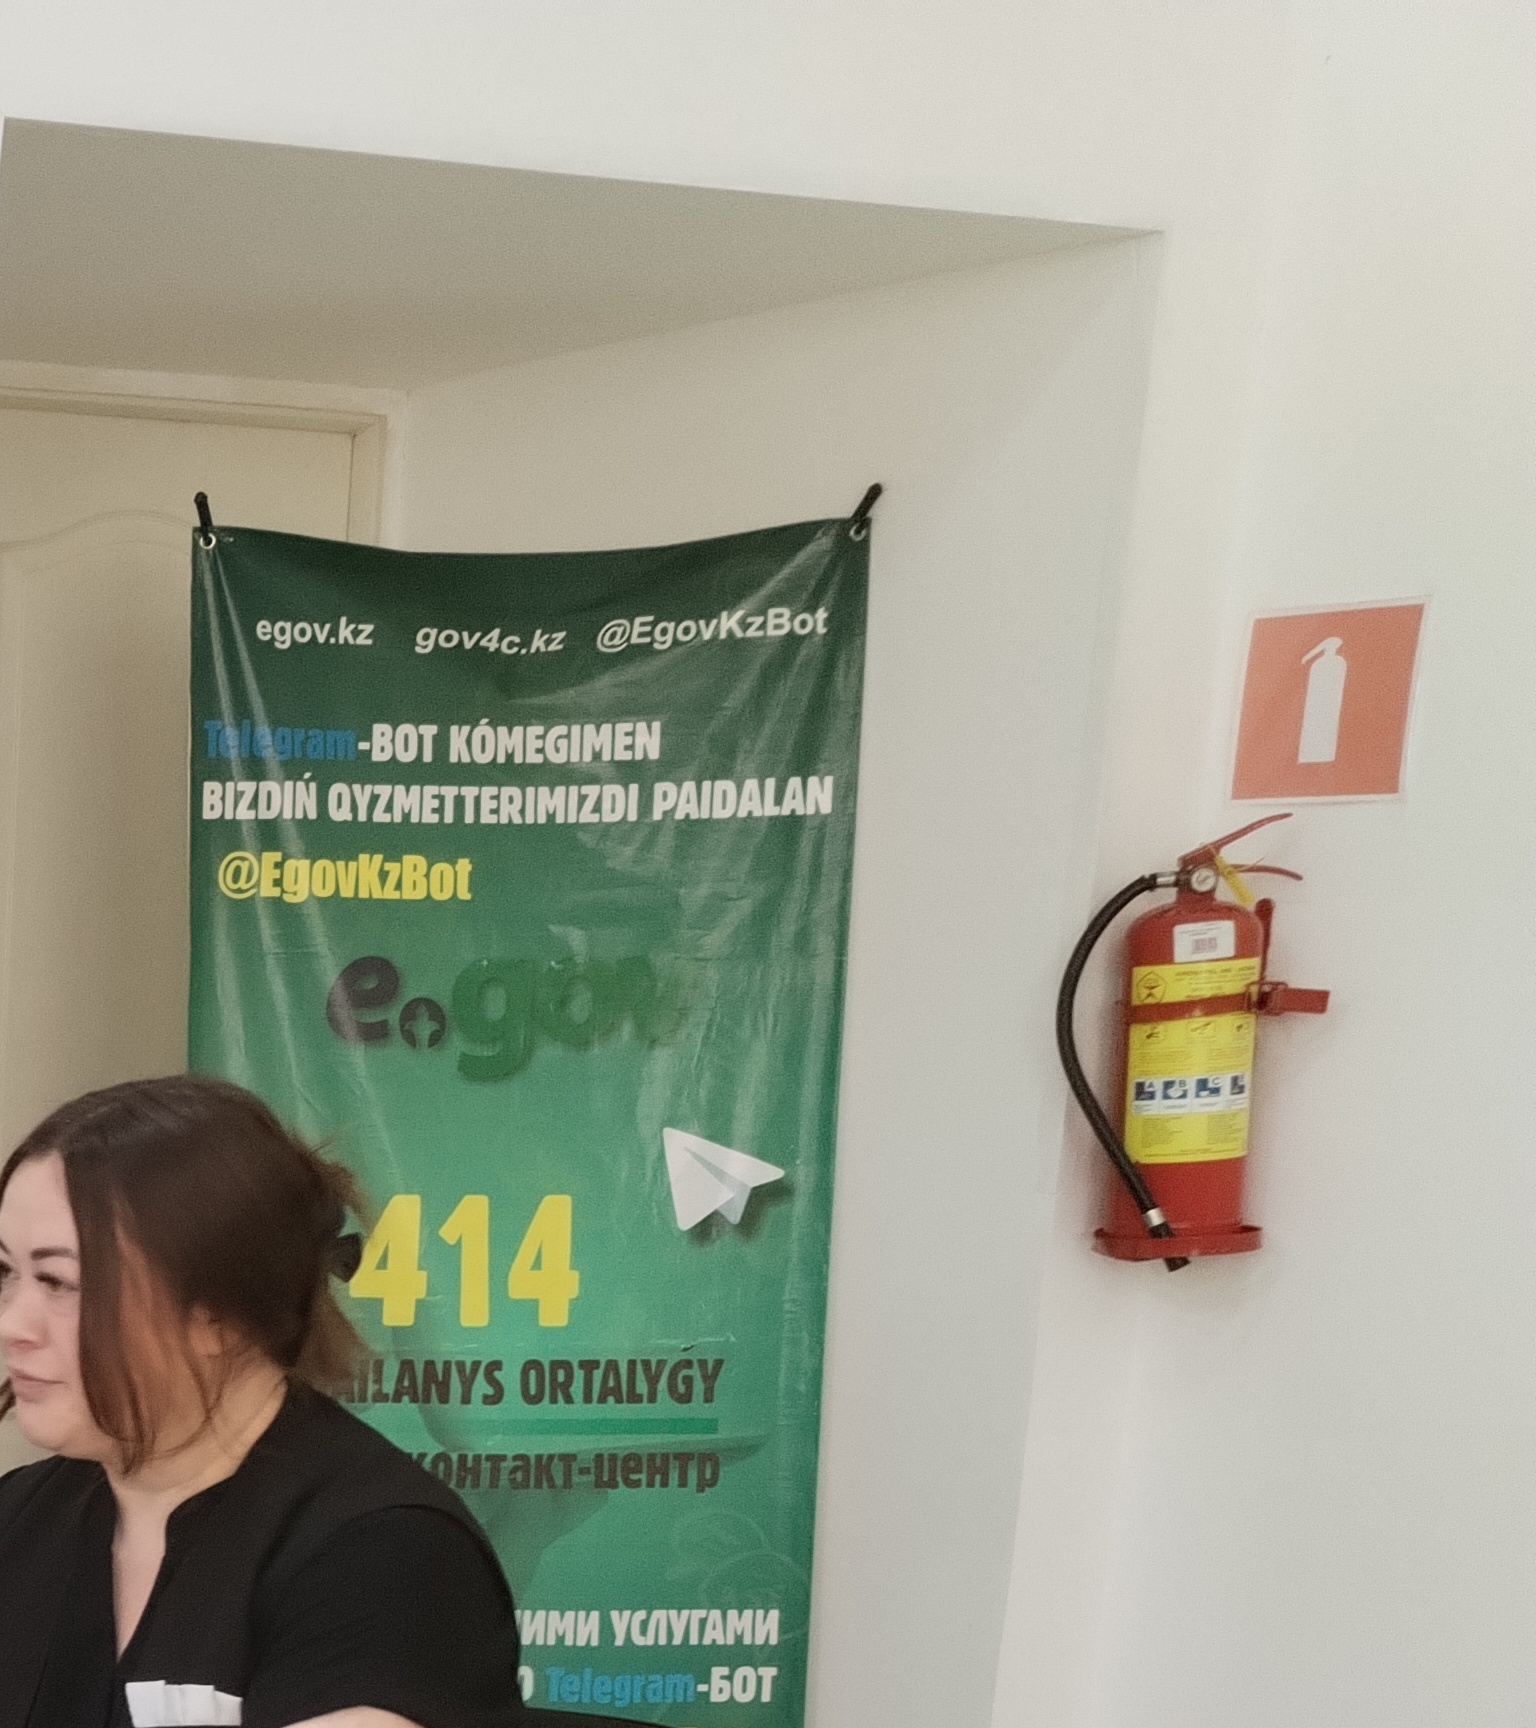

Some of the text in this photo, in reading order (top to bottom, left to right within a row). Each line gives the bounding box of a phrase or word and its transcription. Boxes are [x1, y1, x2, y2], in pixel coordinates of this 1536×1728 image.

[255, 616, 375, 646] egov.kz
[414, 625, 567, 656] gov4c.kz
[596, 606, 829, 654] @EgovKzBot
[328, 783, 640, 825] QYZMETTERIMIZDI
[653, 775, 834, 822] PAIDALAN
[217, 851, 472, 903] @EgovKzBot
[515, 1609, 779, 1646] ИМИ УСЛУГАМИ
